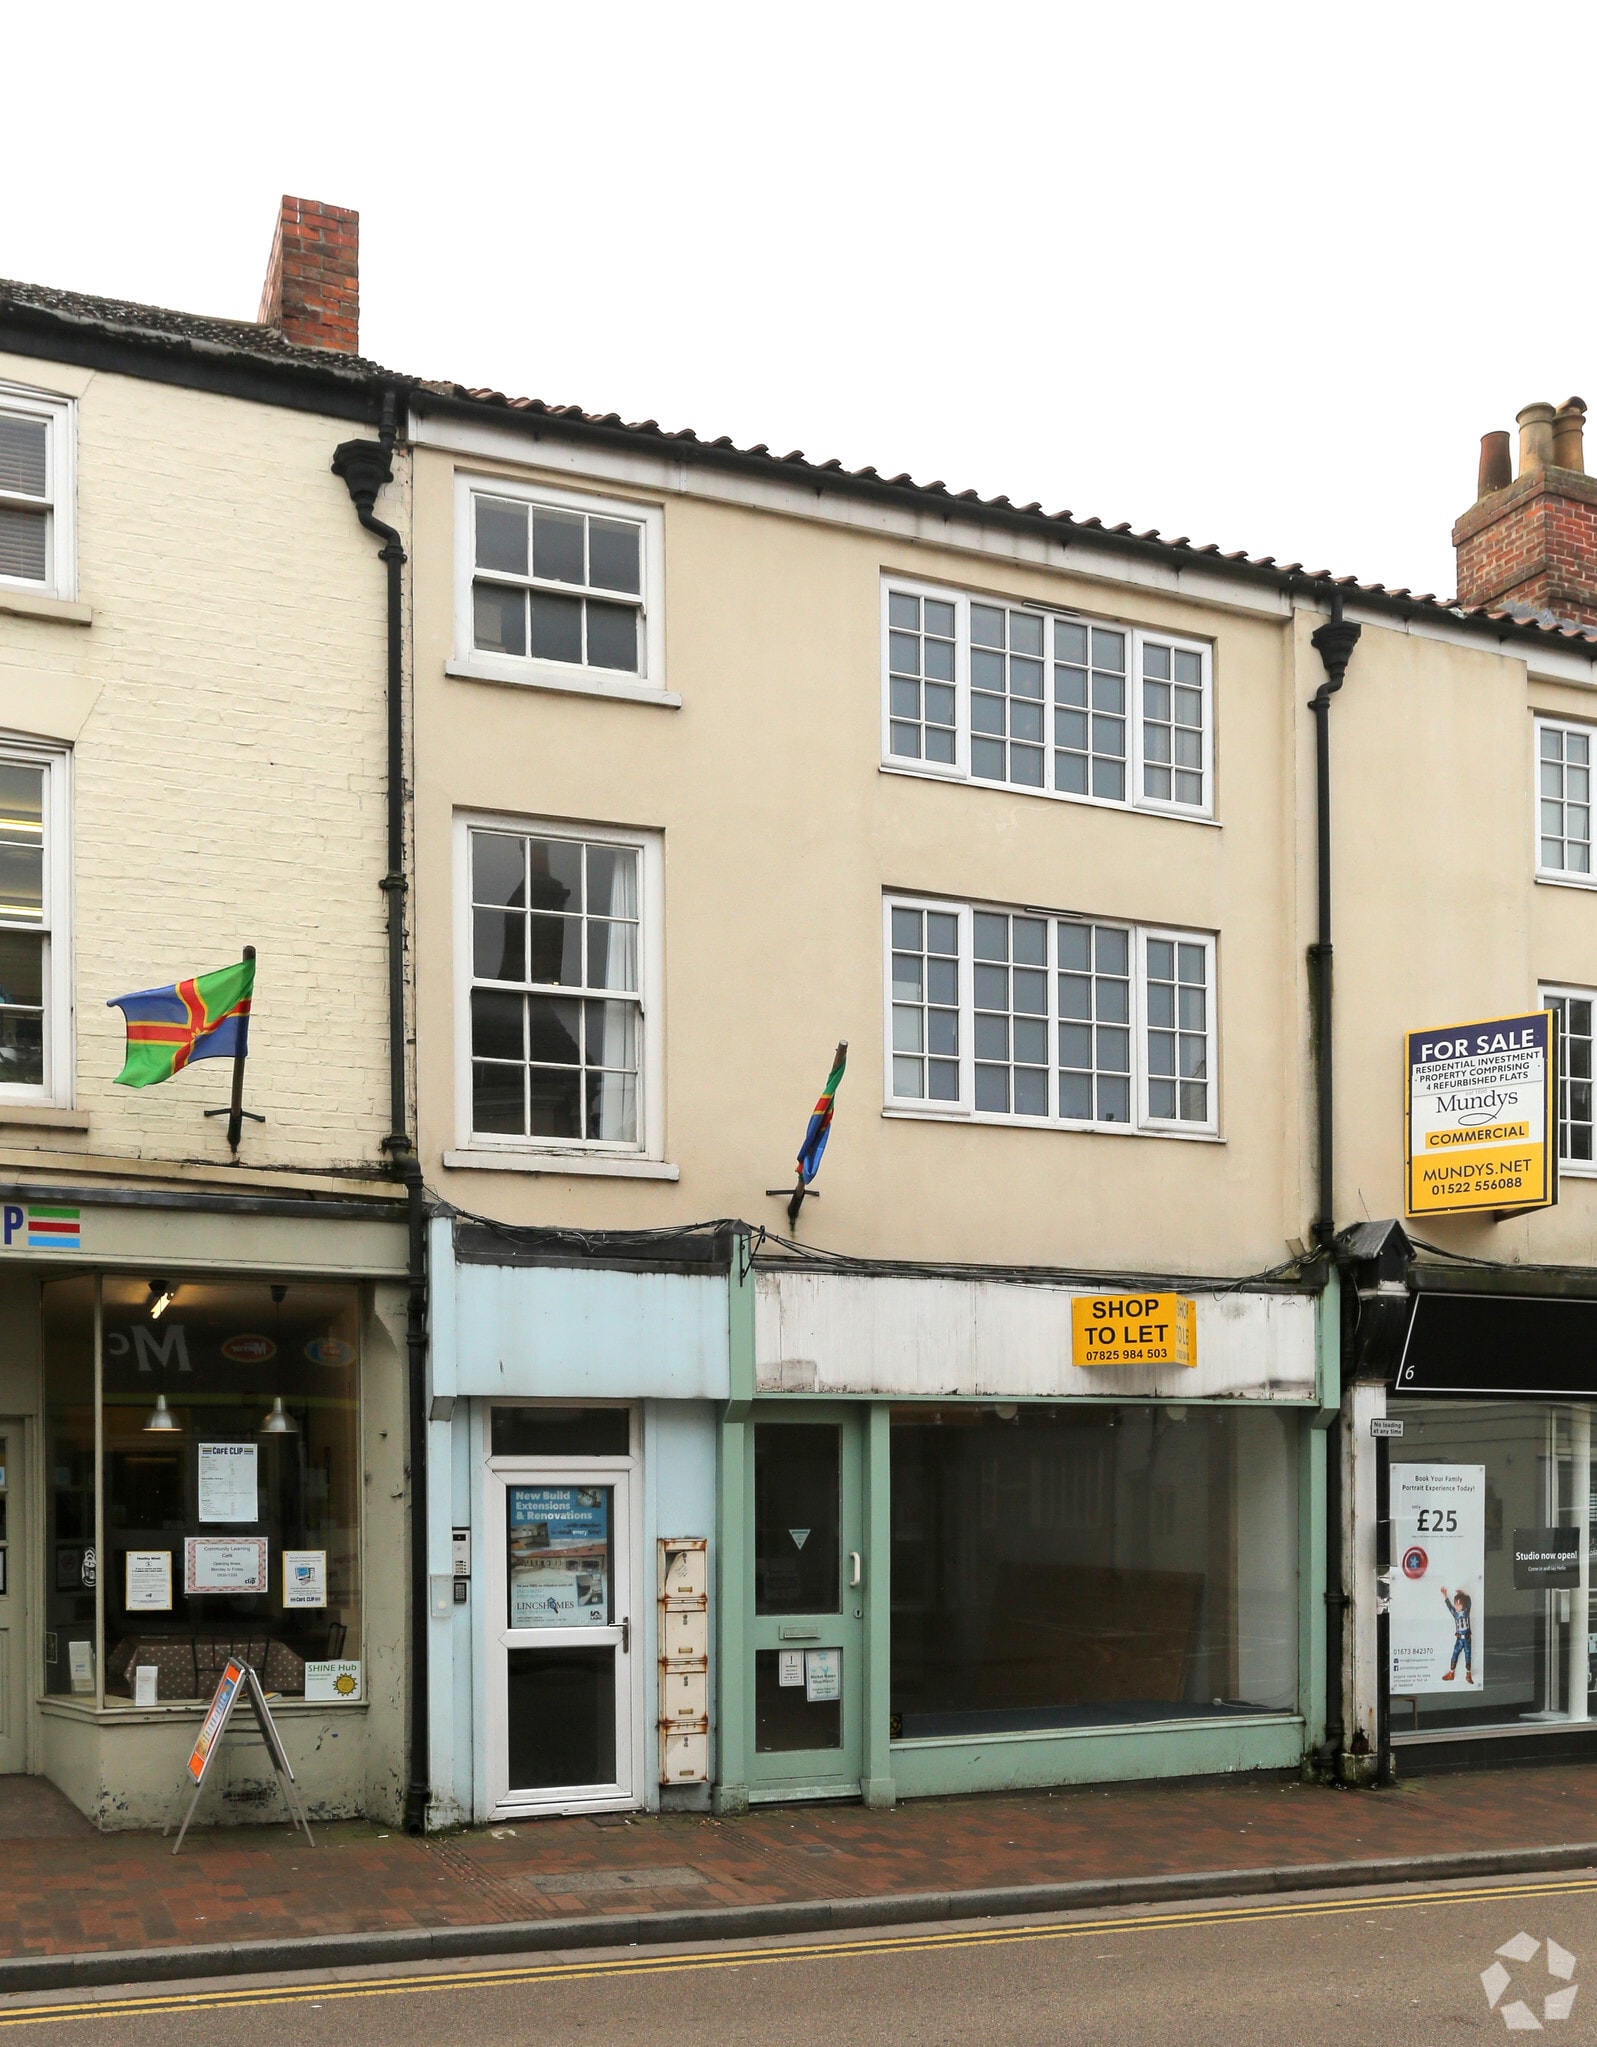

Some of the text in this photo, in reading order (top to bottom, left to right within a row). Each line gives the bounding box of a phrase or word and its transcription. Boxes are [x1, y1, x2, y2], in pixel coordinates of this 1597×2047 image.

[1421, 1029, 1534, 1062] FOR SALE
[1415, 1051, 1540, 1074] RESIDENTIAL INVESTMENT
[1420, 1062, 1530, 1083] PROPERTY COMPRISING
[1433, 1075, 1497, 1090] REFURBISHED
[1499, 1071, 1528, 1082] FLATS
[1436, 1090, 1518, 1125] Mundys
[1429, 1125, 1525, 1145] COMMERCIAL
[1423, 1158, 1532, 1181] MUNDYS.NET
[1432, 1177, 1522, 1195] 01522 556088
[1092, 1299, 1159, 1319] SHOP
[1084, 1324, 1168, 1345] TO LET
[1086, 1350, 1119, 1360] 07825
[1122, 1349, 1143, 1359] 984
[1147, 1348, 1167, 1358] 503
[1405, 1365, 1415, 1380] 6
[515, 1491, 571, 1500] New Build
[515, 1501, 571, 1510] Extensions
[516, 1511, 593, 1520] & Renovations
[1417, 1509, 1458, 1532] £25
[1515, 1551, 1540, 1561] Studio
[1557, 1551, 1578, 1561] open!
